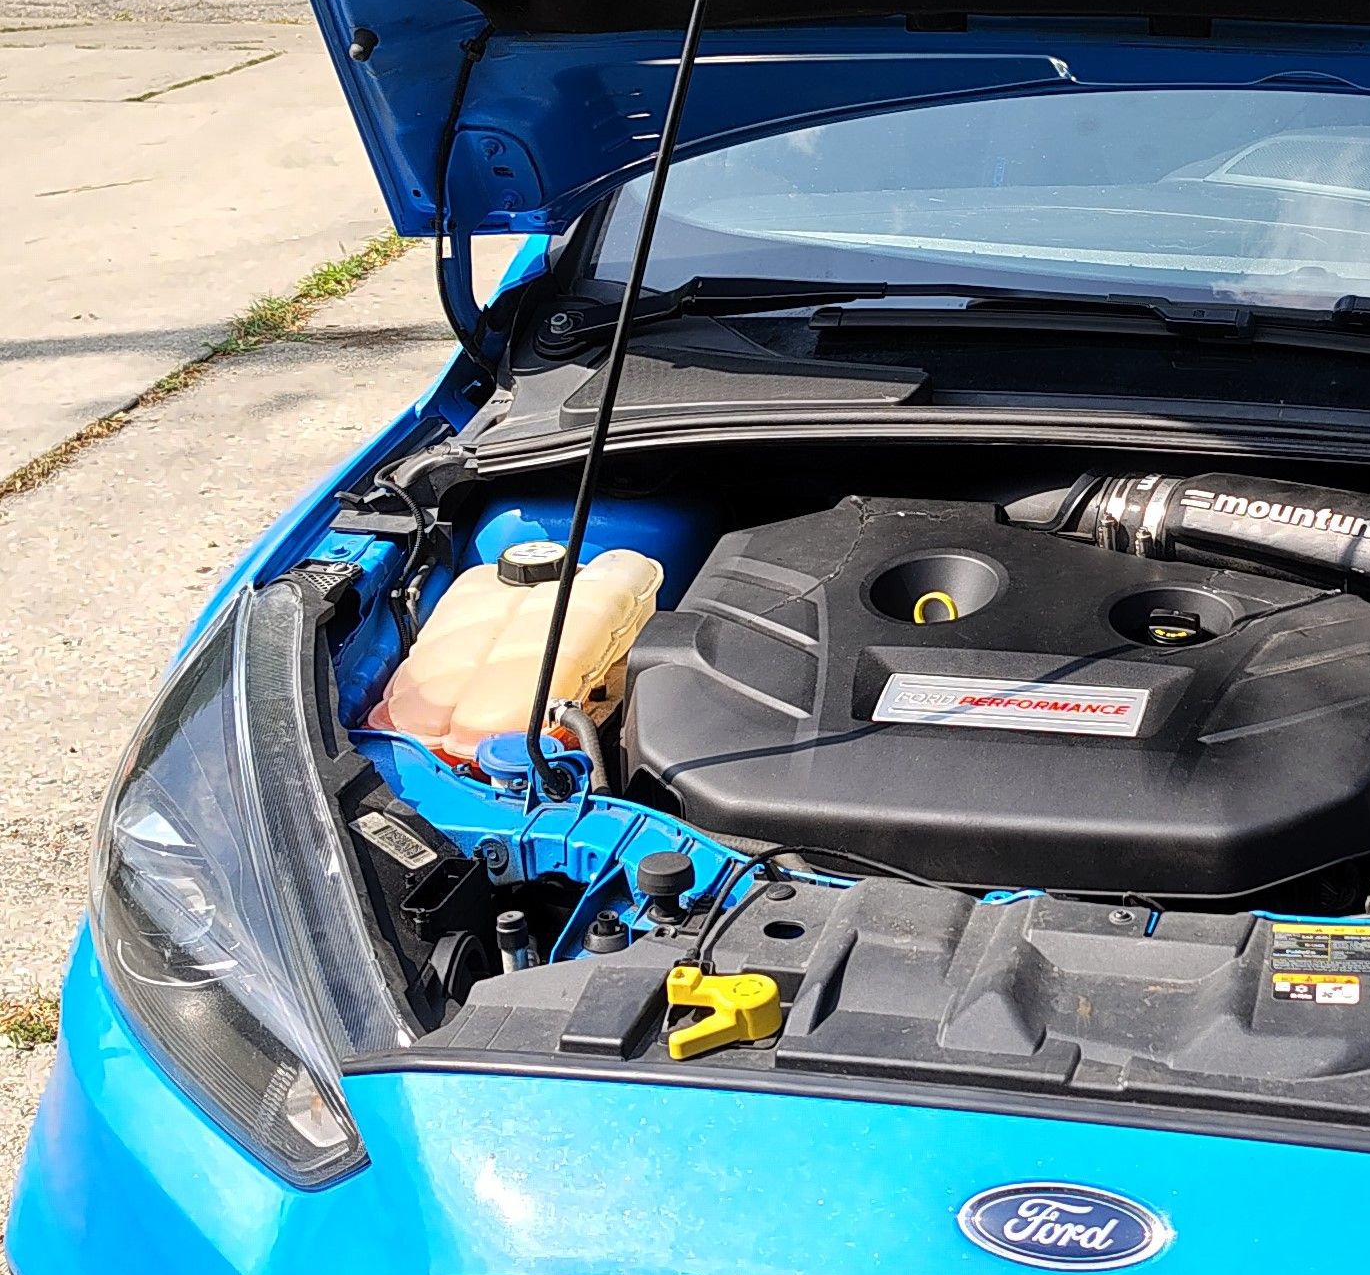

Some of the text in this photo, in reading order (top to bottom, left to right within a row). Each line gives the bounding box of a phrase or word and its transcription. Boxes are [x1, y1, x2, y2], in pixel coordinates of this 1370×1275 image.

[895, 691, 1131, 716] FORD PERFORMANCE
[1003, 1197, 1120, 1251] Ford
